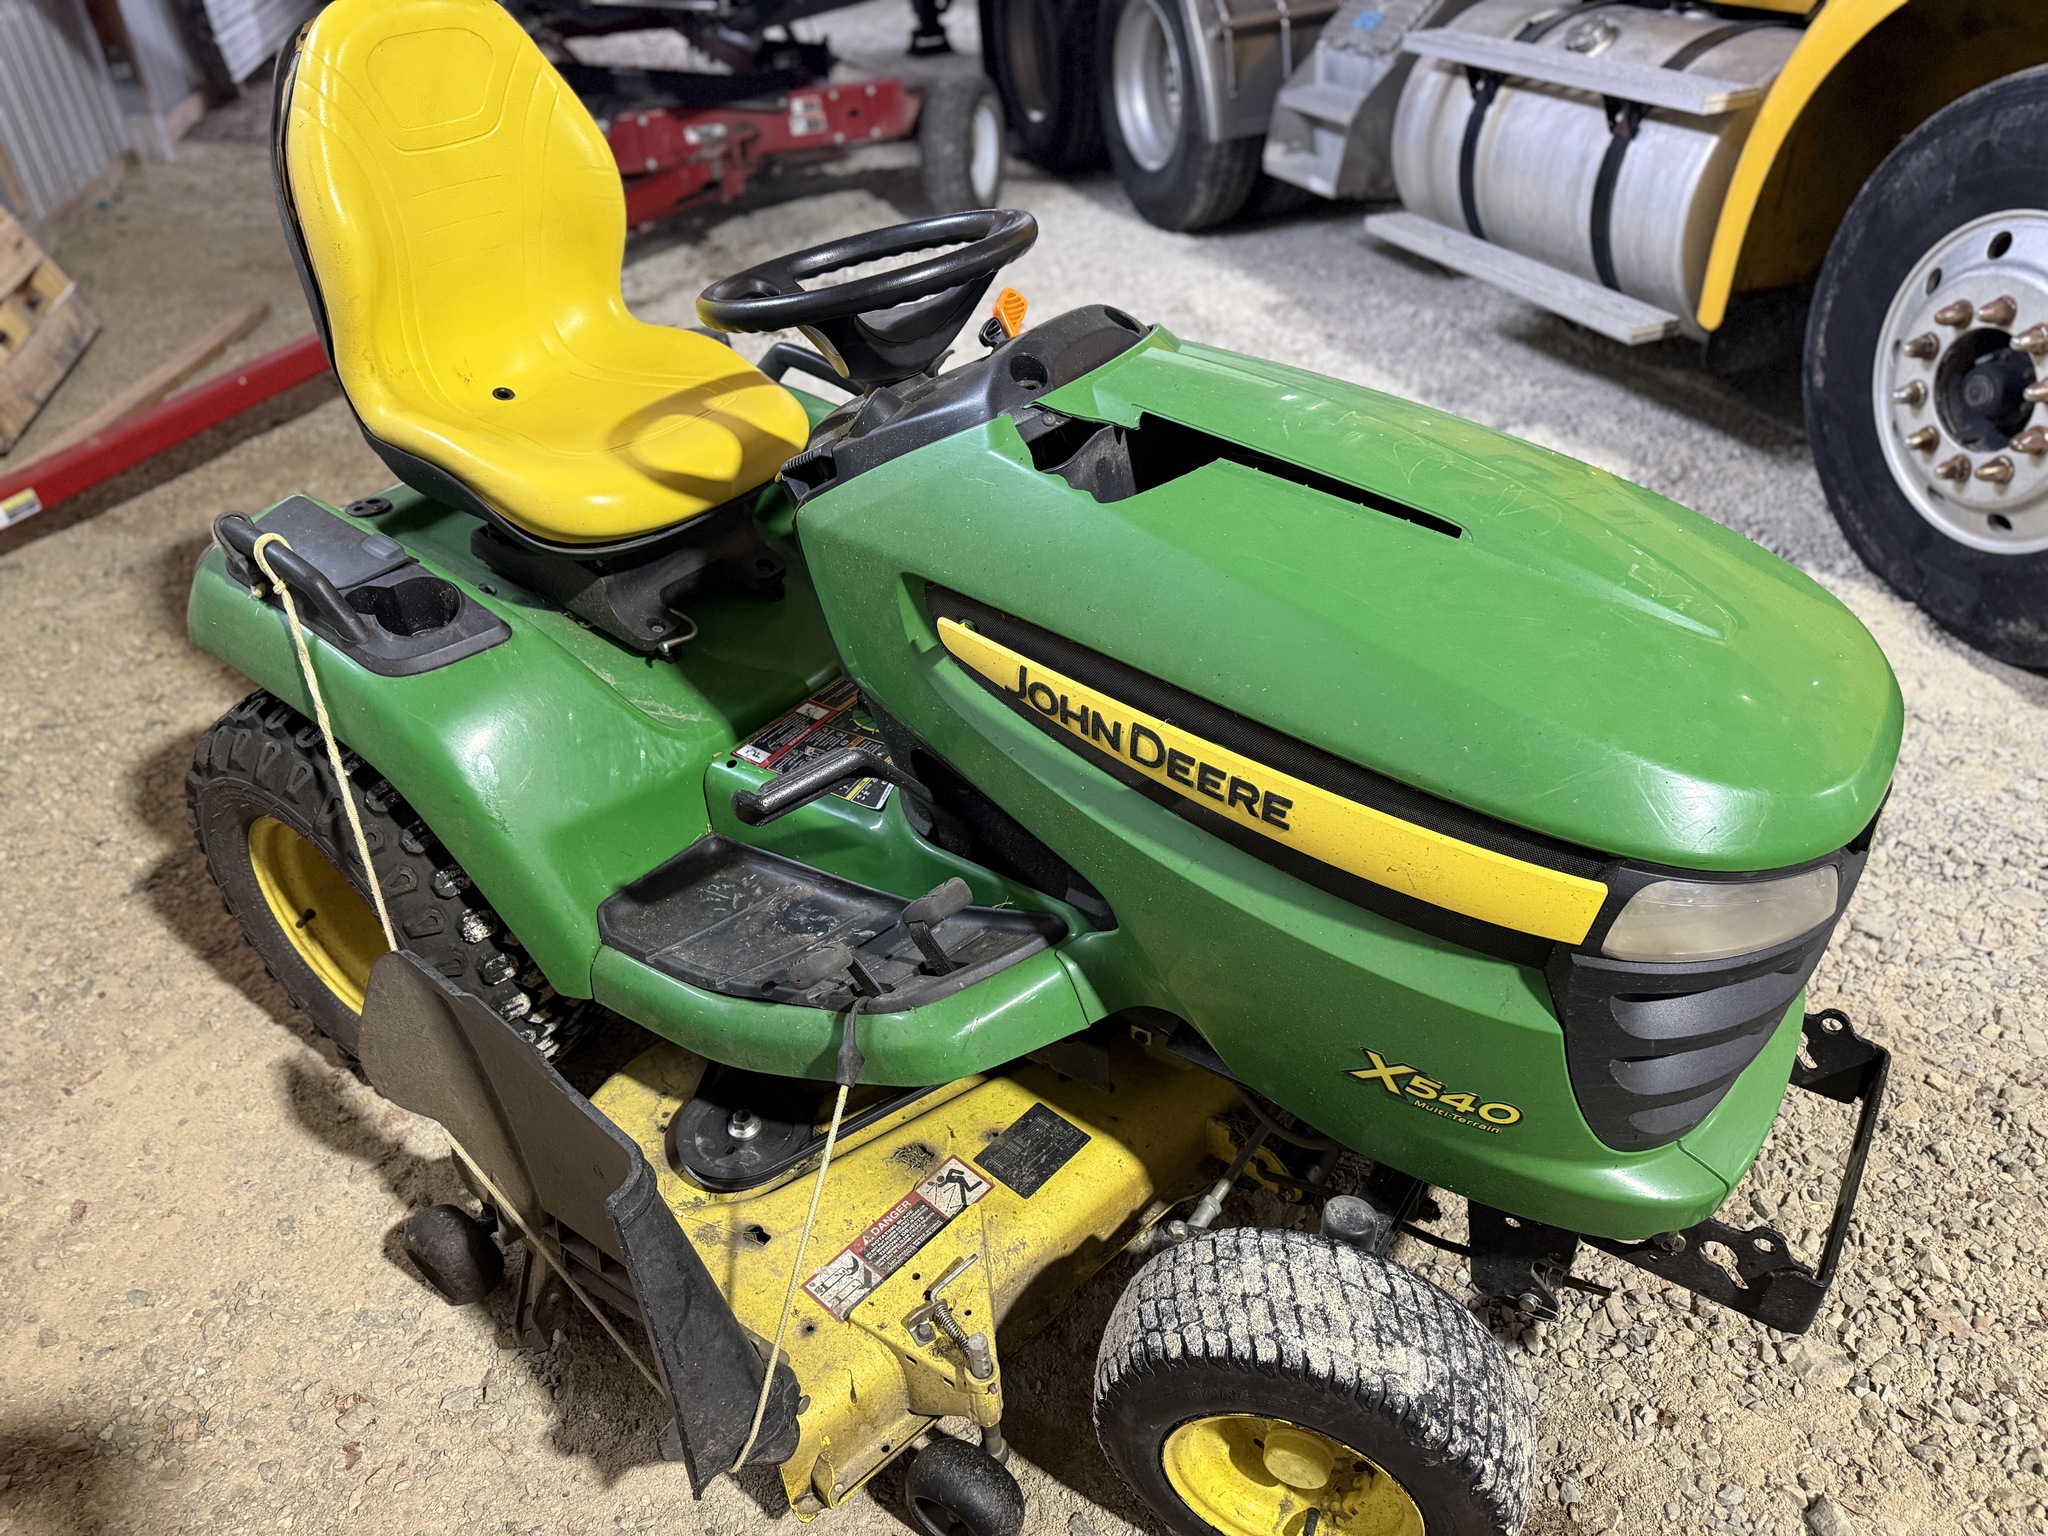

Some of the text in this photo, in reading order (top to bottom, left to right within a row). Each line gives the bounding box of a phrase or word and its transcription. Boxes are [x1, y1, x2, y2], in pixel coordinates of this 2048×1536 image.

[1004, 665, 1294, 831] JOHN DEERE
[1340, 1046, 1524, 1126] X540
[1413, 1099, 1502, 1134] Multi-Terrain
[870, 1199, 911, 1236] DANGER
[870, 1209, 914, 1247] ROTATING BLADE
[878, 1215, 924, 1256] THROWN OBJECTS
[1186, 1387, 1326, 1420] CARLISLE
